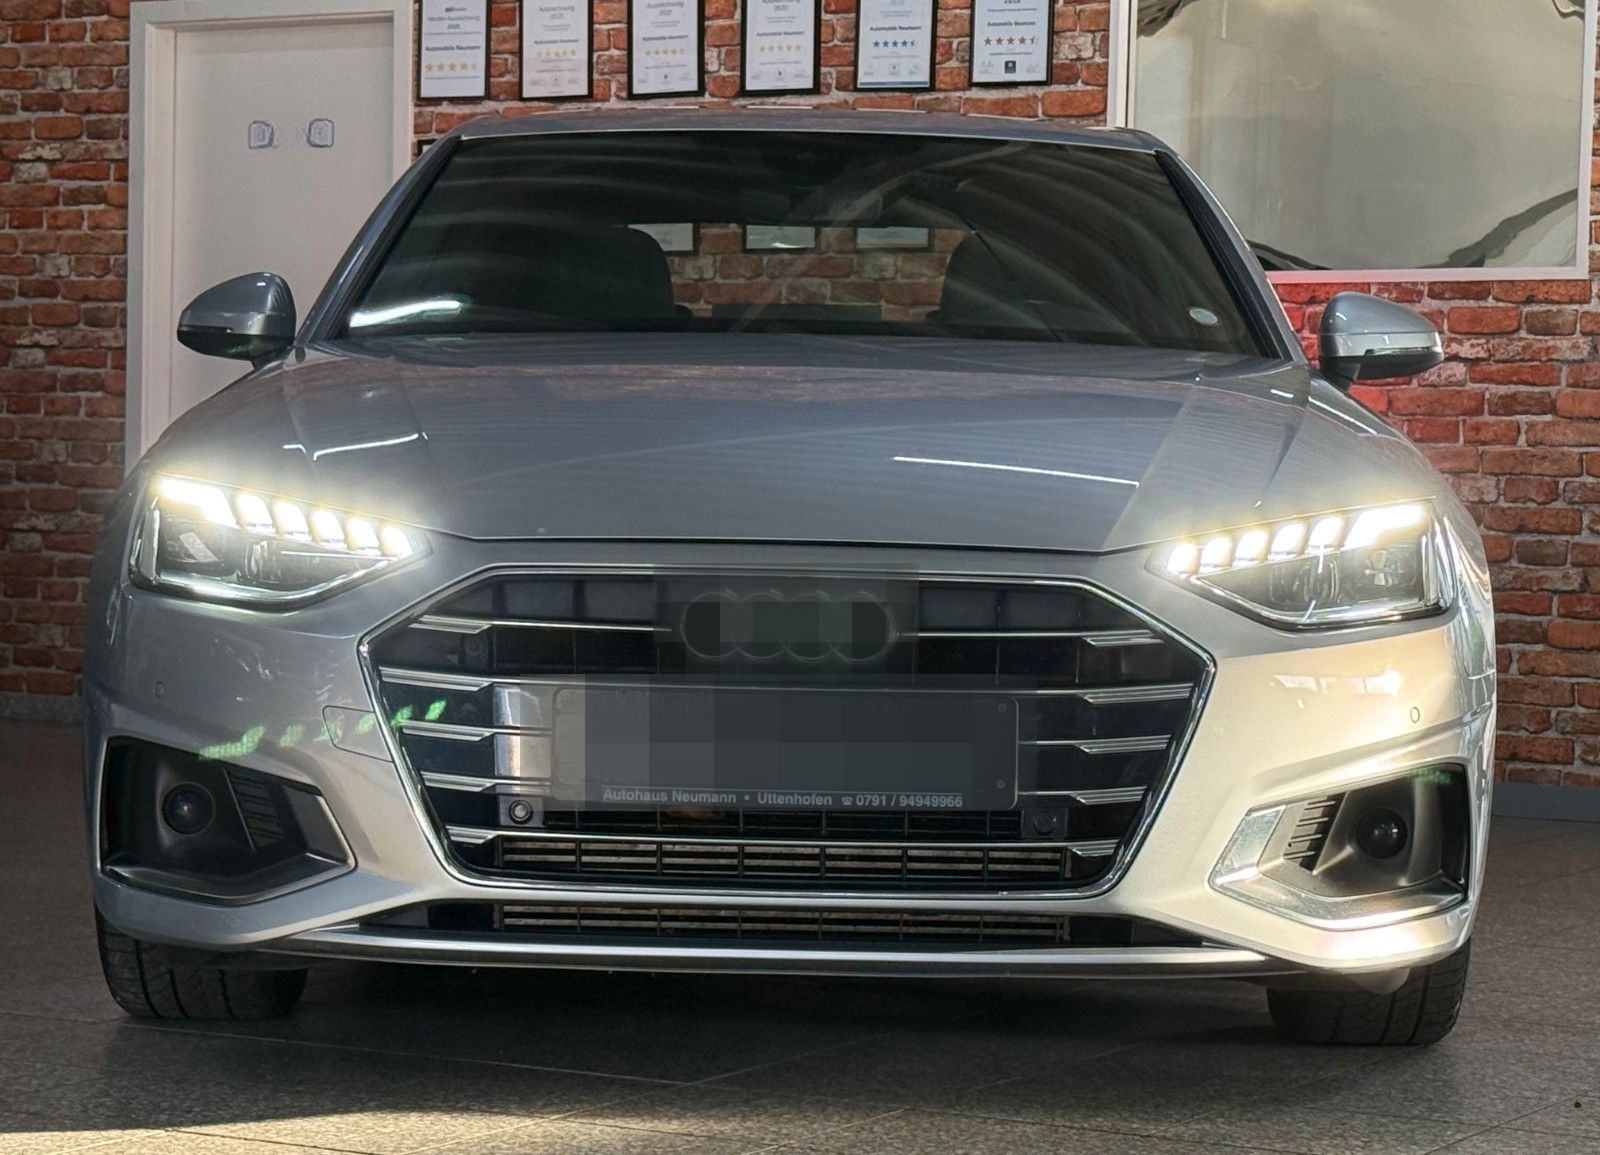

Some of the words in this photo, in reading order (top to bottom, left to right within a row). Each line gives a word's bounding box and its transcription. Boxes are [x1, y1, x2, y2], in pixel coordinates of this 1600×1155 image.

[603, 788, 668, 801] Autohaus
[671, 790, 737, 803] Neumann
[757, 791, 833, 806] Uttenhofen
[855, 794, 887, 807] 0791
[899, 795, 963, 808] 94949966
